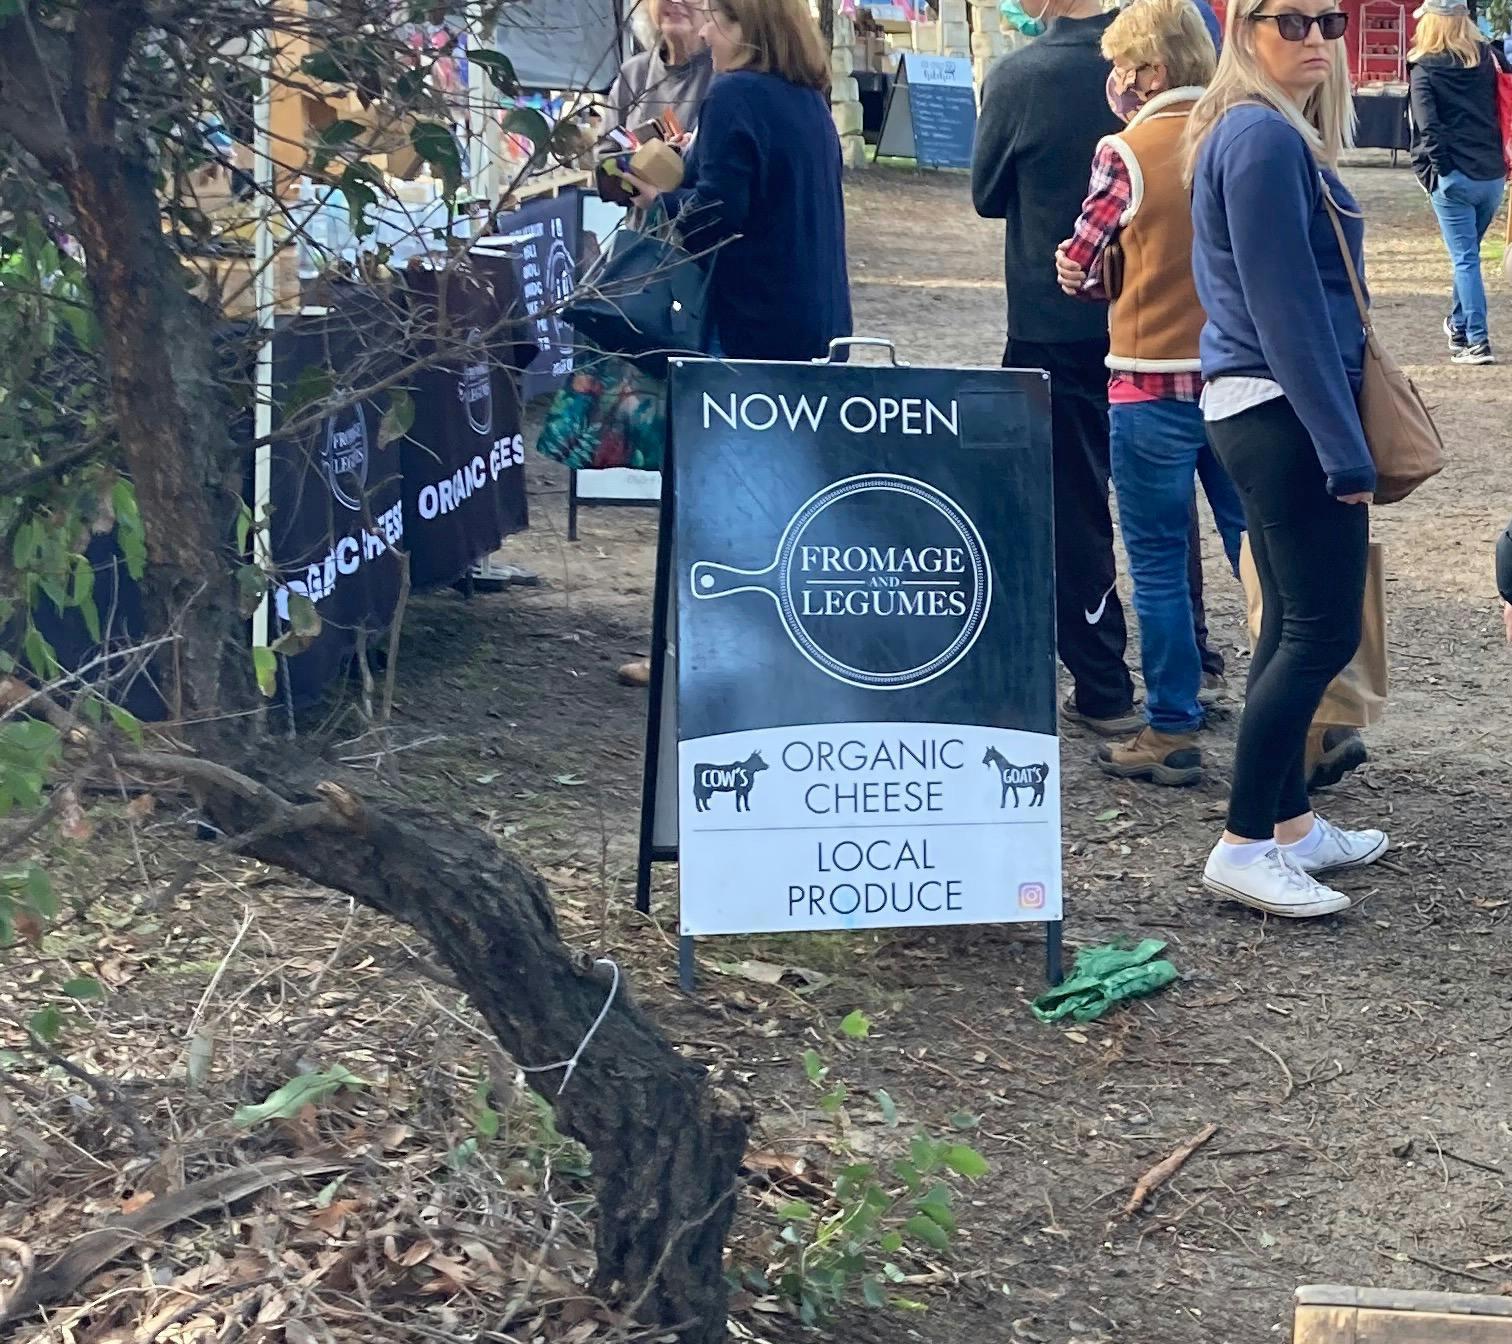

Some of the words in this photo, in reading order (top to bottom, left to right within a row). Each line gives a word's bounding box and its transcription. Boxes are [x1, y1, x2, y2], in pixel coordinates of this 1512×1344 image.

[702, 391, 828, 432] NOW
[839, 396, 959, 436] OPEN
[800, 545, 966, 574] FROMAGE
[868, 577, 900, 588] AND
[800, 590, 966, 616] LEGUMES
[781, 739, 965, 773] ORGANIC
[701, 768, 750, 789] COW'S
[1002, 766, 1043, 785] GOAT'S
[804, 781, 944, 814] CHEESE
[817, 839, 936, 872] LOCAL
[788, 880, 963, 916] PRODUCE
